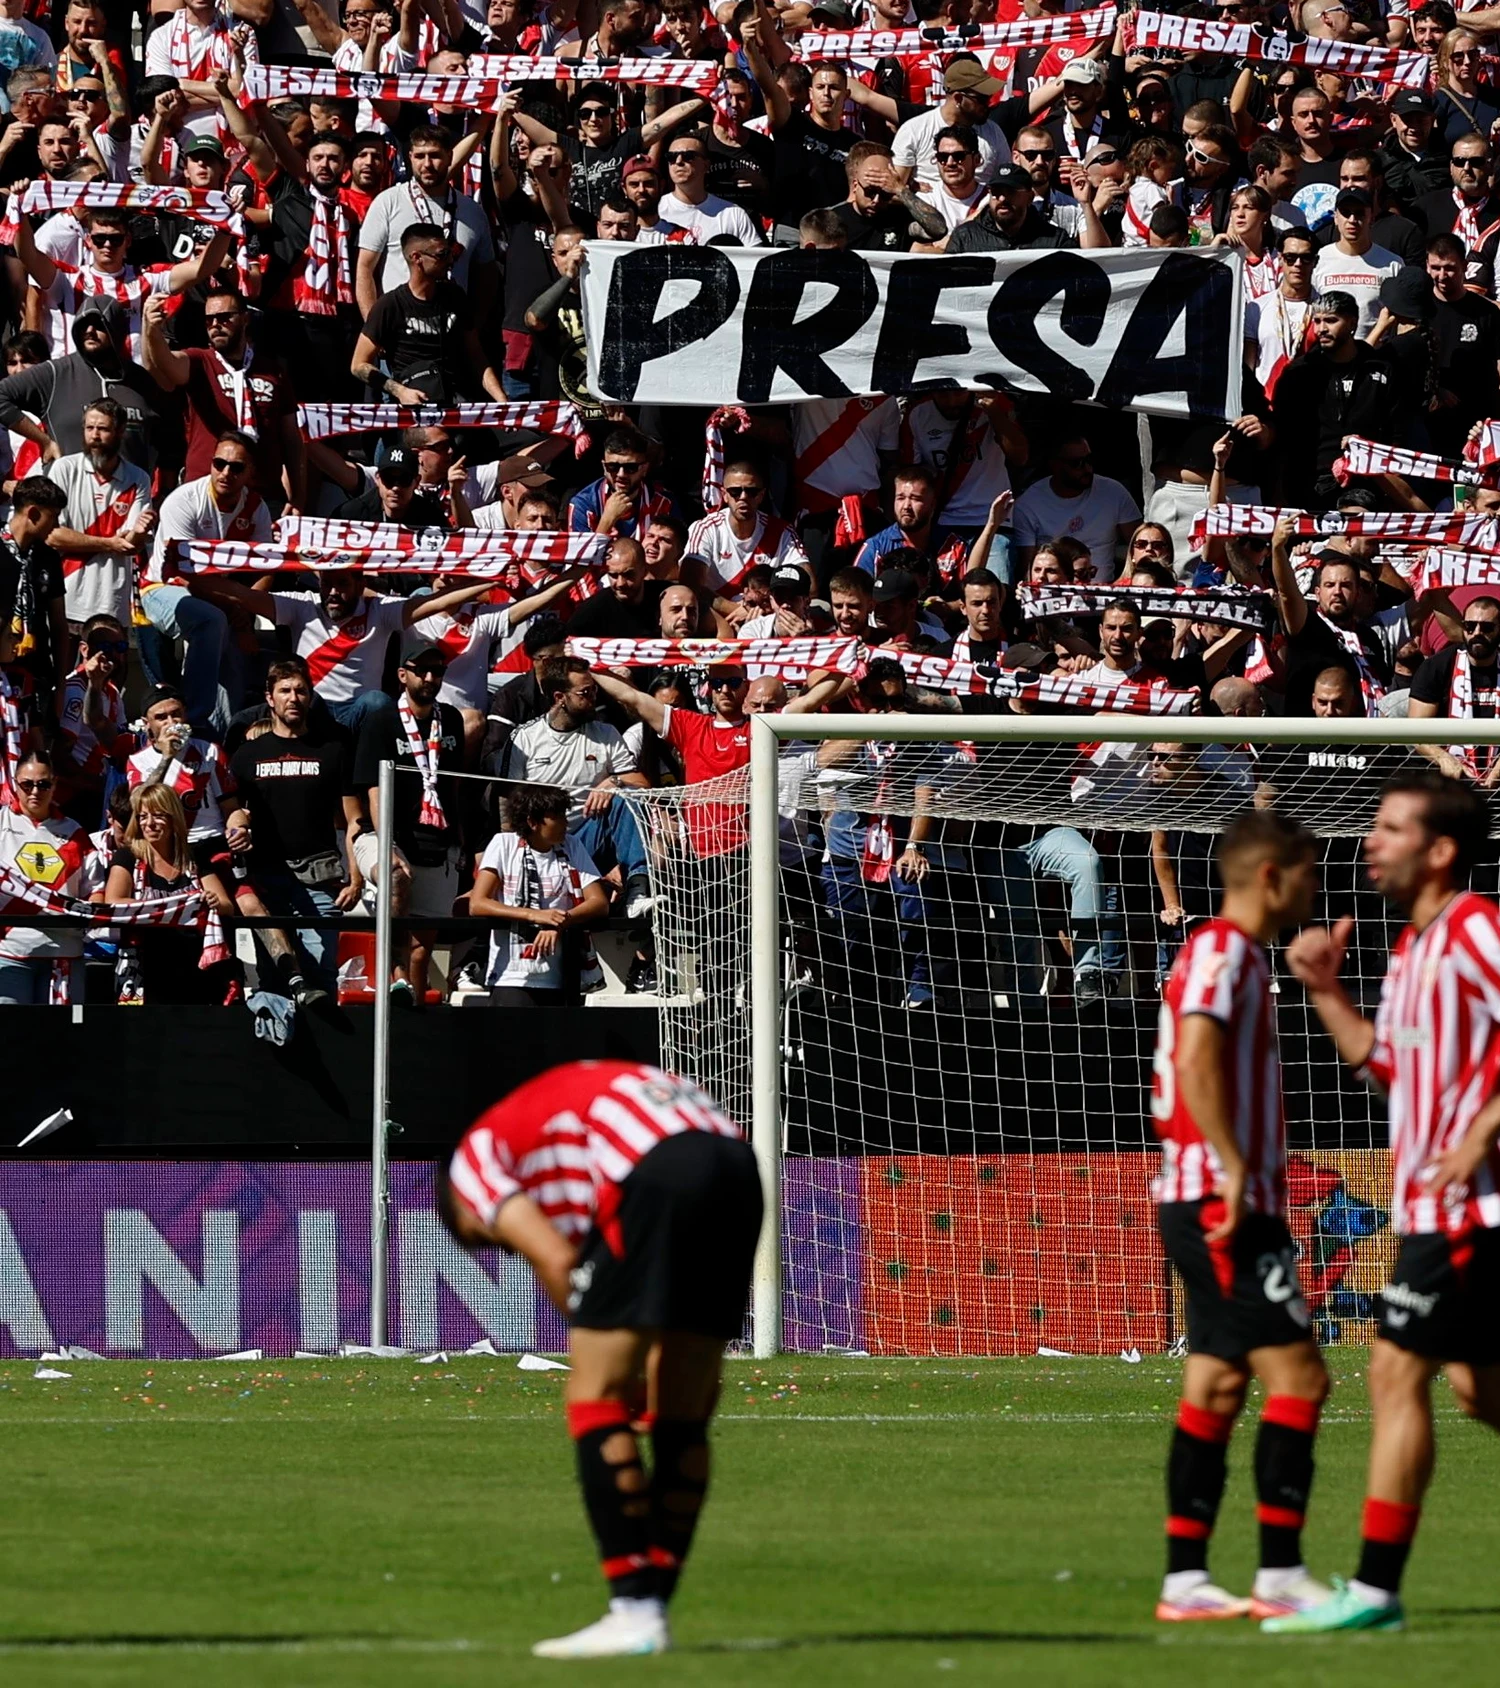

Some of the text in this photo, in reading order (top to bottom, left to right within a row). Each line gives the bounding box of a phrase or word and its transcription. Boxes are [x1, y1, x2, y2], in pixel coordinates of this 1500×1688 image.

[800, 30, 922, 60] PRESA
[982, 16, 1072, 48] VETE
[1136, 10, 1251, 56] PRESA
[1304, 36, 1387, 77] VETE
[397, 72, 484, 106] VETE
[618, 57, 715, 89] VETE
[1326, 274, 1377, 286] Bukaneros
[599, 244, 1234, 419] PRESA
[459, 401, 550, 428] VETE
[278, 516, 399, 550] PRESA
[459, 529, 556, 560] VETE
[1362, 512, 1452, 541] VETE
[178, 540, 514, 578] SOS RAYO
[569, 636, 672, 668] SOS
[868, 648, 972, 693] ESA
[1038, 675, 1142, 711] VETE
[282, 762, 301, 775] AWAY
[301, 762, 320, 776] DAYS
[111, 890, 202, 926] VETE
